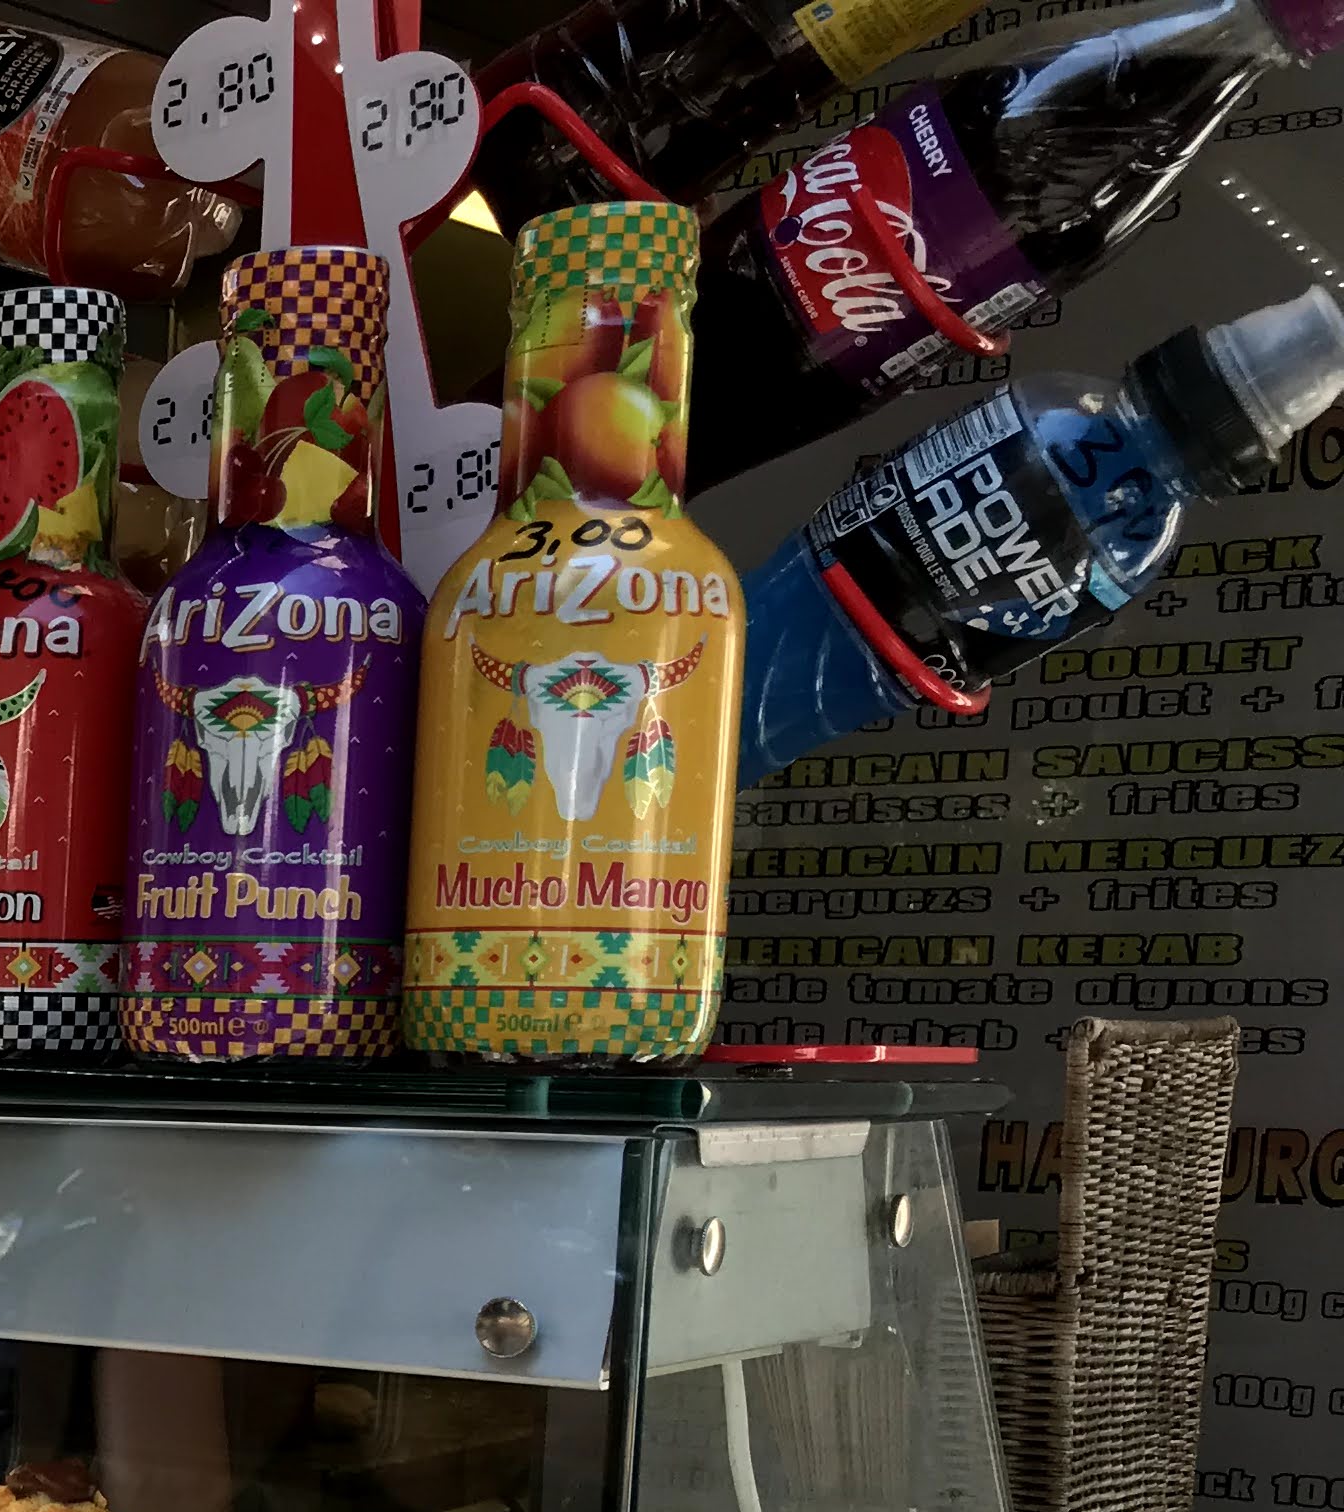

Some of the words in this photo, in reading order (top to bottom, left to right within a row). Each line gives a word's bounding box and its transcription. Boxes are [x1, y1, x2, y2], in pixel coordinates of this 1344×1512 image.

[5, 50, 46, 99] ORANGE
[10, 55, 53, 111] SANGUINE
[908, 103, 954, 178] CHERRY
[796, 288, 820, 321] cerise
[894, 501, 921, 538] BOISSON
[912, 534, 934, 566] POUR
[935, 571, 960, 601] SPORT
[914, 478, 1003, 591] ADE
[956, 453, 1080, 622] POWER
[1162, 534, 1323, 580] ACK
[444, 555, 732, 640] AriZona
[139, 582, 403, 664] AriZona
[1039, 636, 1304, 685] POULET
[1011, 681, 1213, 732] poulet
[1108, 779, 1300, 816] frites
[142, 842, 233, 871] Cowboy
[242, 843, 363, 867] Cocktail
[1023, 834, 1344, 874] MERGUEZ
[136, 871, 219, 920] Fruit
[223, 872, 362, 920] Punch
[435, 861, 568, 913] Mucho
[576, 861, 710, 924] Mango
[1088, 876, 1279, 912] frites
[1017, 932, 1244, 968] KEBAB
[848, 972, 1053, 1005] tomate
[1075, 972, 1329, 1011] oignons
[168, 1016, 225, 1036] 500ml
[845, 1016, 1018, 1056] kebab
[1214, 1374, 1315, 1418] 100g
